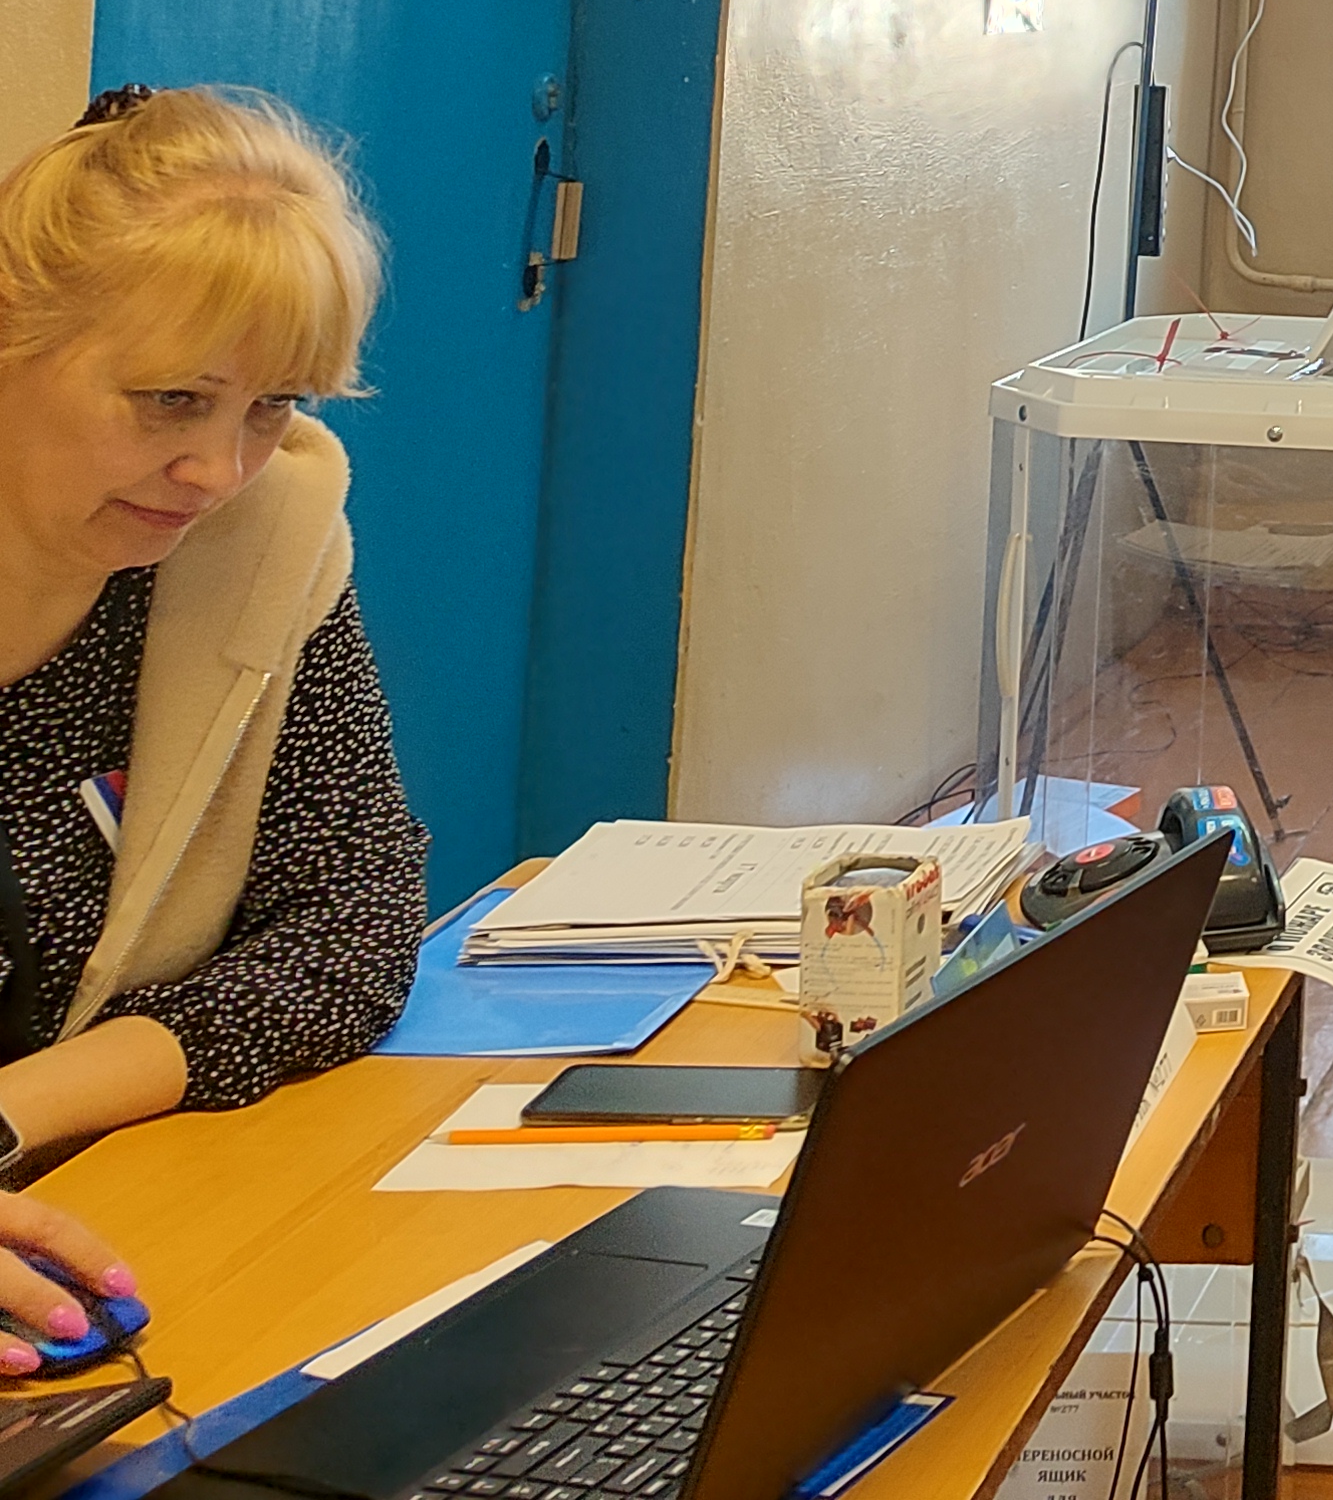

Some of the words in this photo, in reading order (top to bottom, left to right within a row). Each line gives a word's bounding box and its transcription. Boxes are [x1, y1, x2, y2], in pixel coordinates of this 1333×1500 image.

[959, 1122, 1026, 1188] acer
[1089, 1390, 1135, 1399] УЧАСТО
[1037, 1469, 1087, 1484] ЯЩИК
